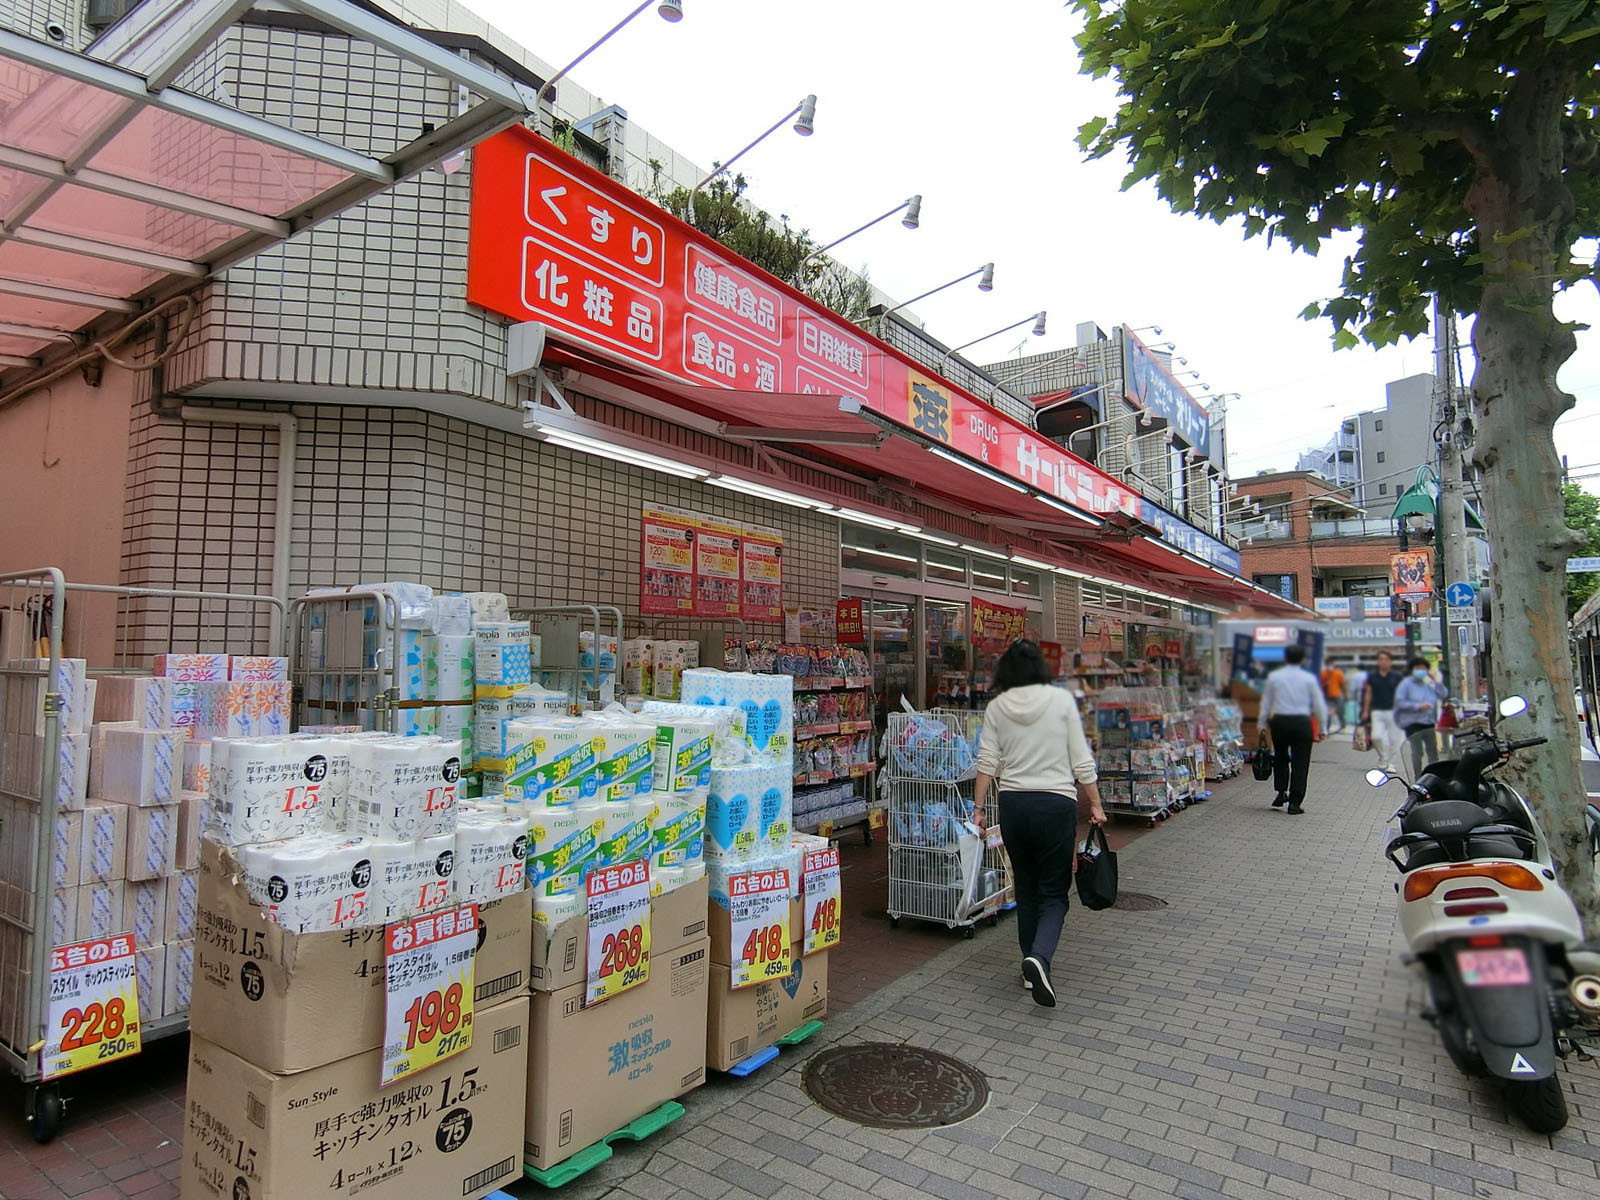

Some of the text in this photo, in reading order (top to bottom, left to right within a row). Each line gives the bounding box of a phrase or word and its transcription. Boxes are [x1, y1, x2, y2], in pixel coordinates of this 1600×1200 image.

[541, 186, 654, 266] くすり
[535, 259, 654, 343] 化粧品
[693, 261, 776, 333] 健康食品
[803, 322, 864, 378] 日用雑貨
[692, 331, 776, 392] 食品・酒
[912, 381, 948, 442] 薬
[970, 414, 998, 443] DRUG
[981, 443, 988, 462] &
[840, 607, 858, 618] 本日
[476, 630, 500, 639] nepia
[507, 630, 530, 638] nepia
[1333, 628, 1394, 639] CHICKEN
[478, 703, 499, 711] nepia
[513, 701, 536, 709] nepia
[543, 701, 567, 709] nepia
[554, 732, 578, 740] nepia
[246, 771, 305, 785] キッチンタオル
[309, 763, 325, 777] 75
[447, 766, 459, 779] 75
[394, 774, 443, 785] キッチンタオル
[553, 819, 579, 828] nepia
[612, 811, 635, 819] nepia
[1431, 819, 1462, 828] YAMAHA
[470, 853, 511, 864] キッチンタオル
[516, 844, 526, 856] 75
[440, 859, 452, 874] 75
[806, 851, 838, 871] 広告の品
[354, 869, 370, 884] 75
[385, 869, 435, 884] キッチンタオル
[590, 864, 646, 894] 広告の品
[733, 872, 786, 894] 広告の品
[270, 884, 284, 898] 75
[294, 880, 351, 900] キッチンタオル
[589, 901, 603, 910] ネピア
[392, 907, 474, 950] お買得品
[388, 952, 433, 974] サンスタイル
[388, 947, 476, 985] キッチンタオル 1.5倍巻き
[85, 963, 135, 987] ボックスティッシュ
[244, 973, 260, 994] 75
[756, 991, 779, 1008] やさしい
[628, 1014, 653, 1031] nepia
[631, 1038, 672, 1064] キッチンタオル
[628, 1062, 653, 1080] 4ロール
[287, 1086, 338, 1110] Sun Style
[314, 1084, 433, 1139] 厚手で強力吸収の
[313, 1101, 432, 1161] キッチンタオル
[442, 1120, 466, 1147] 75
